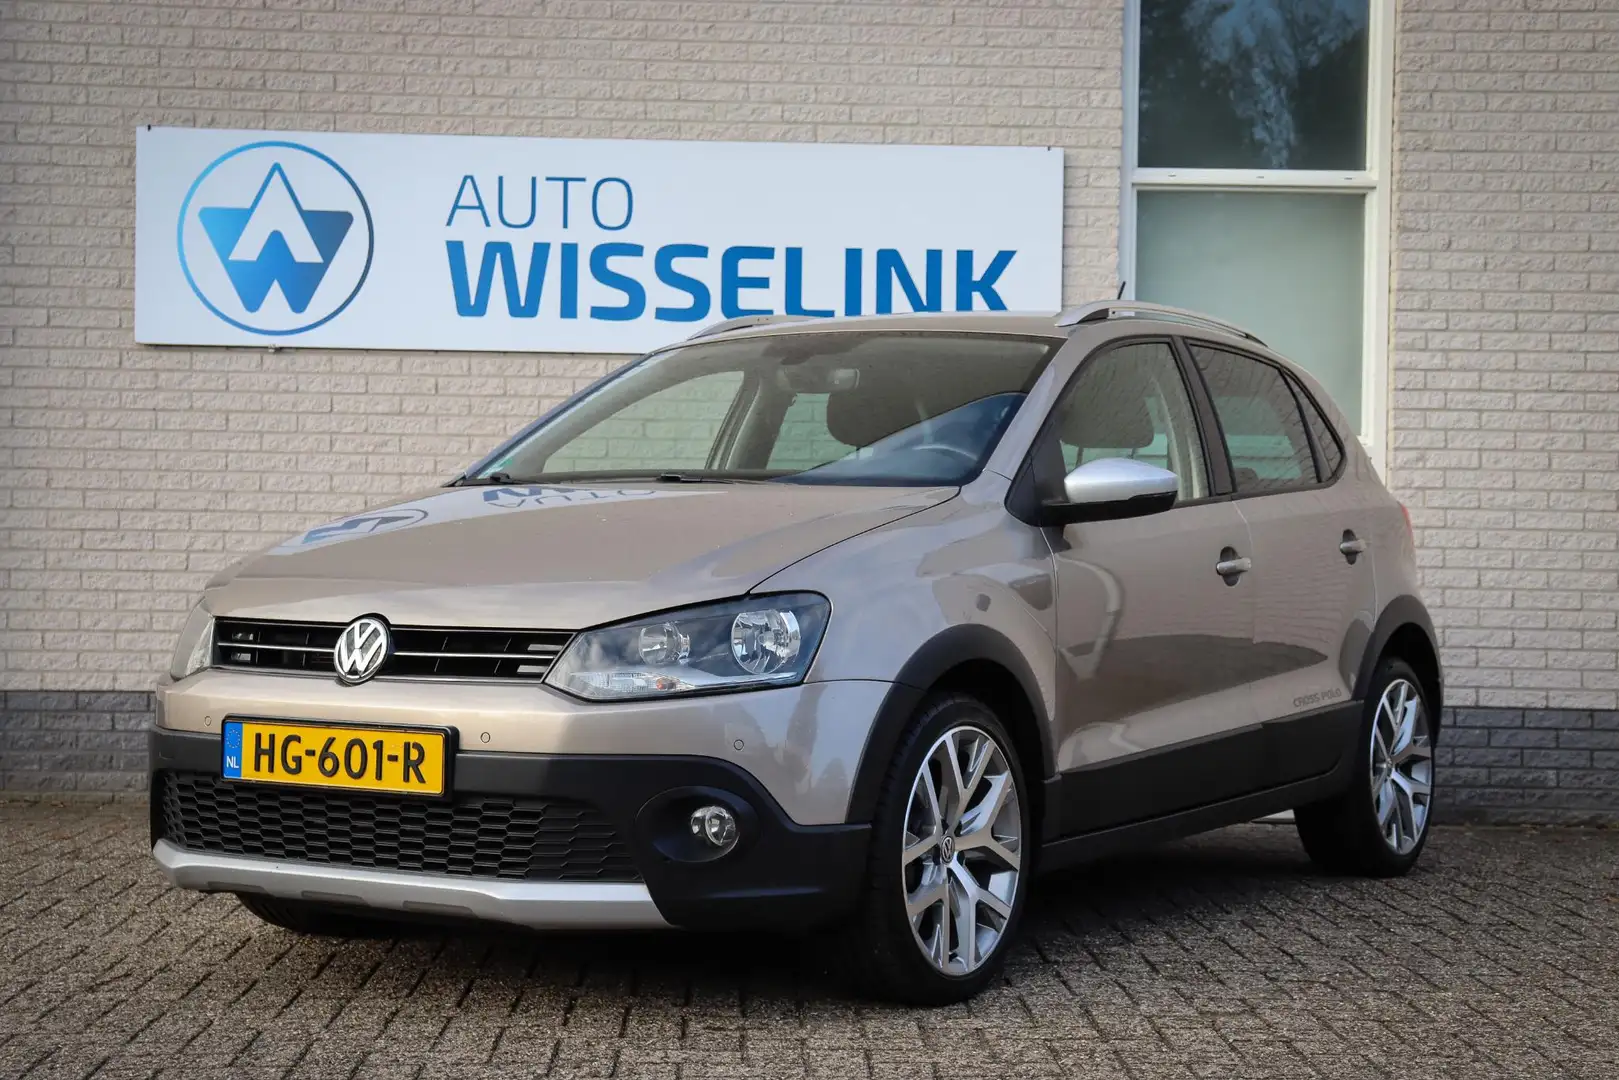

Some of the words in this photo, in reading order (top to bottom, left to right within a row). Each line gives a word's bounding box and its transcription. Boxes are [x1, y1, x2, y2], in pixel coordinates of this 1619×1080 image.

[446, 175, 634, 231] AUTO
[445, 240, 1018, 322] WISSELINK
[226, 755, 240, 769] NL
[254, 731, 426, 784] HG-601-R
